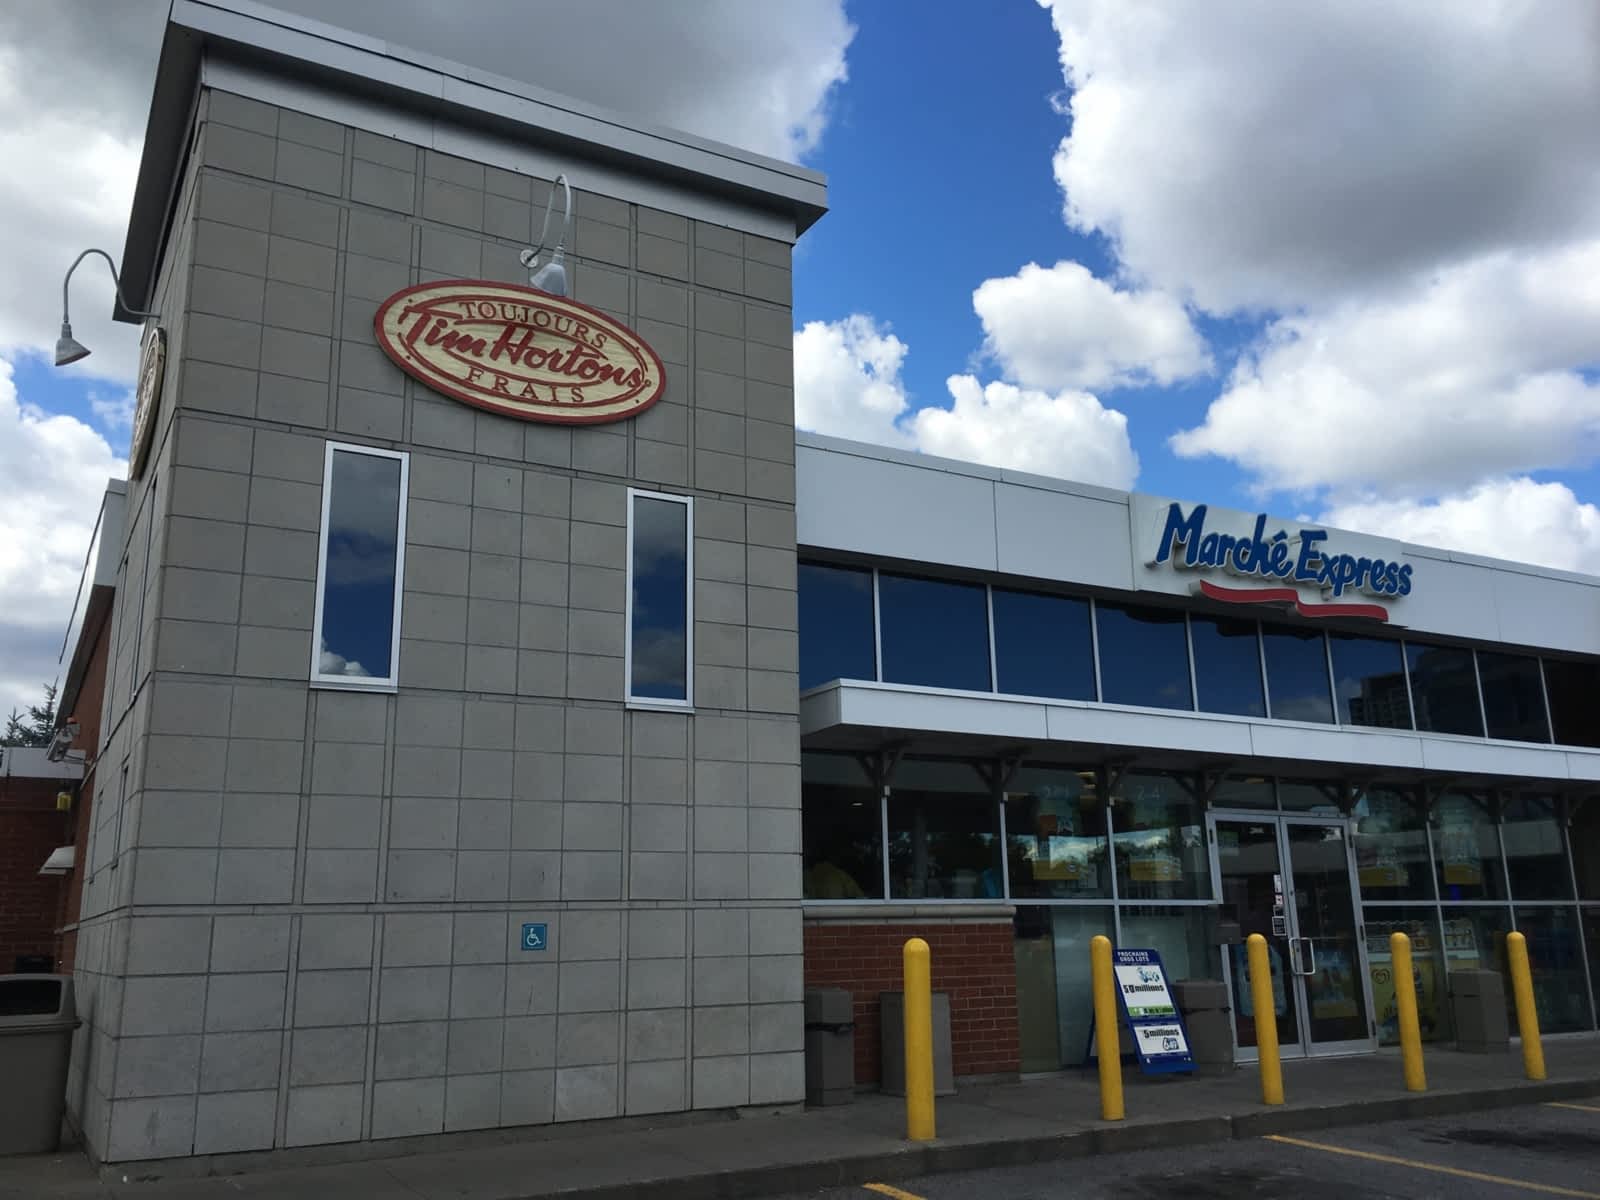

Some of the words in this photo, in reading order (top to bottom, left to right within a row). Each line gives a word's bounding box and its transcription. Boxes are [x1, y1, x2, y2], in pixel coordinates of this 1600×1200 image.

[397, 305, 484, 358] Tim
[488, 323, 642, 388] Hortons
[459, 301, 608, 350] TOUJOURS
[463, 366, 585, 403] FRAIS
[1155, 502, 1295, 577] Marché
[1295, 529, 1413, 597] Express
